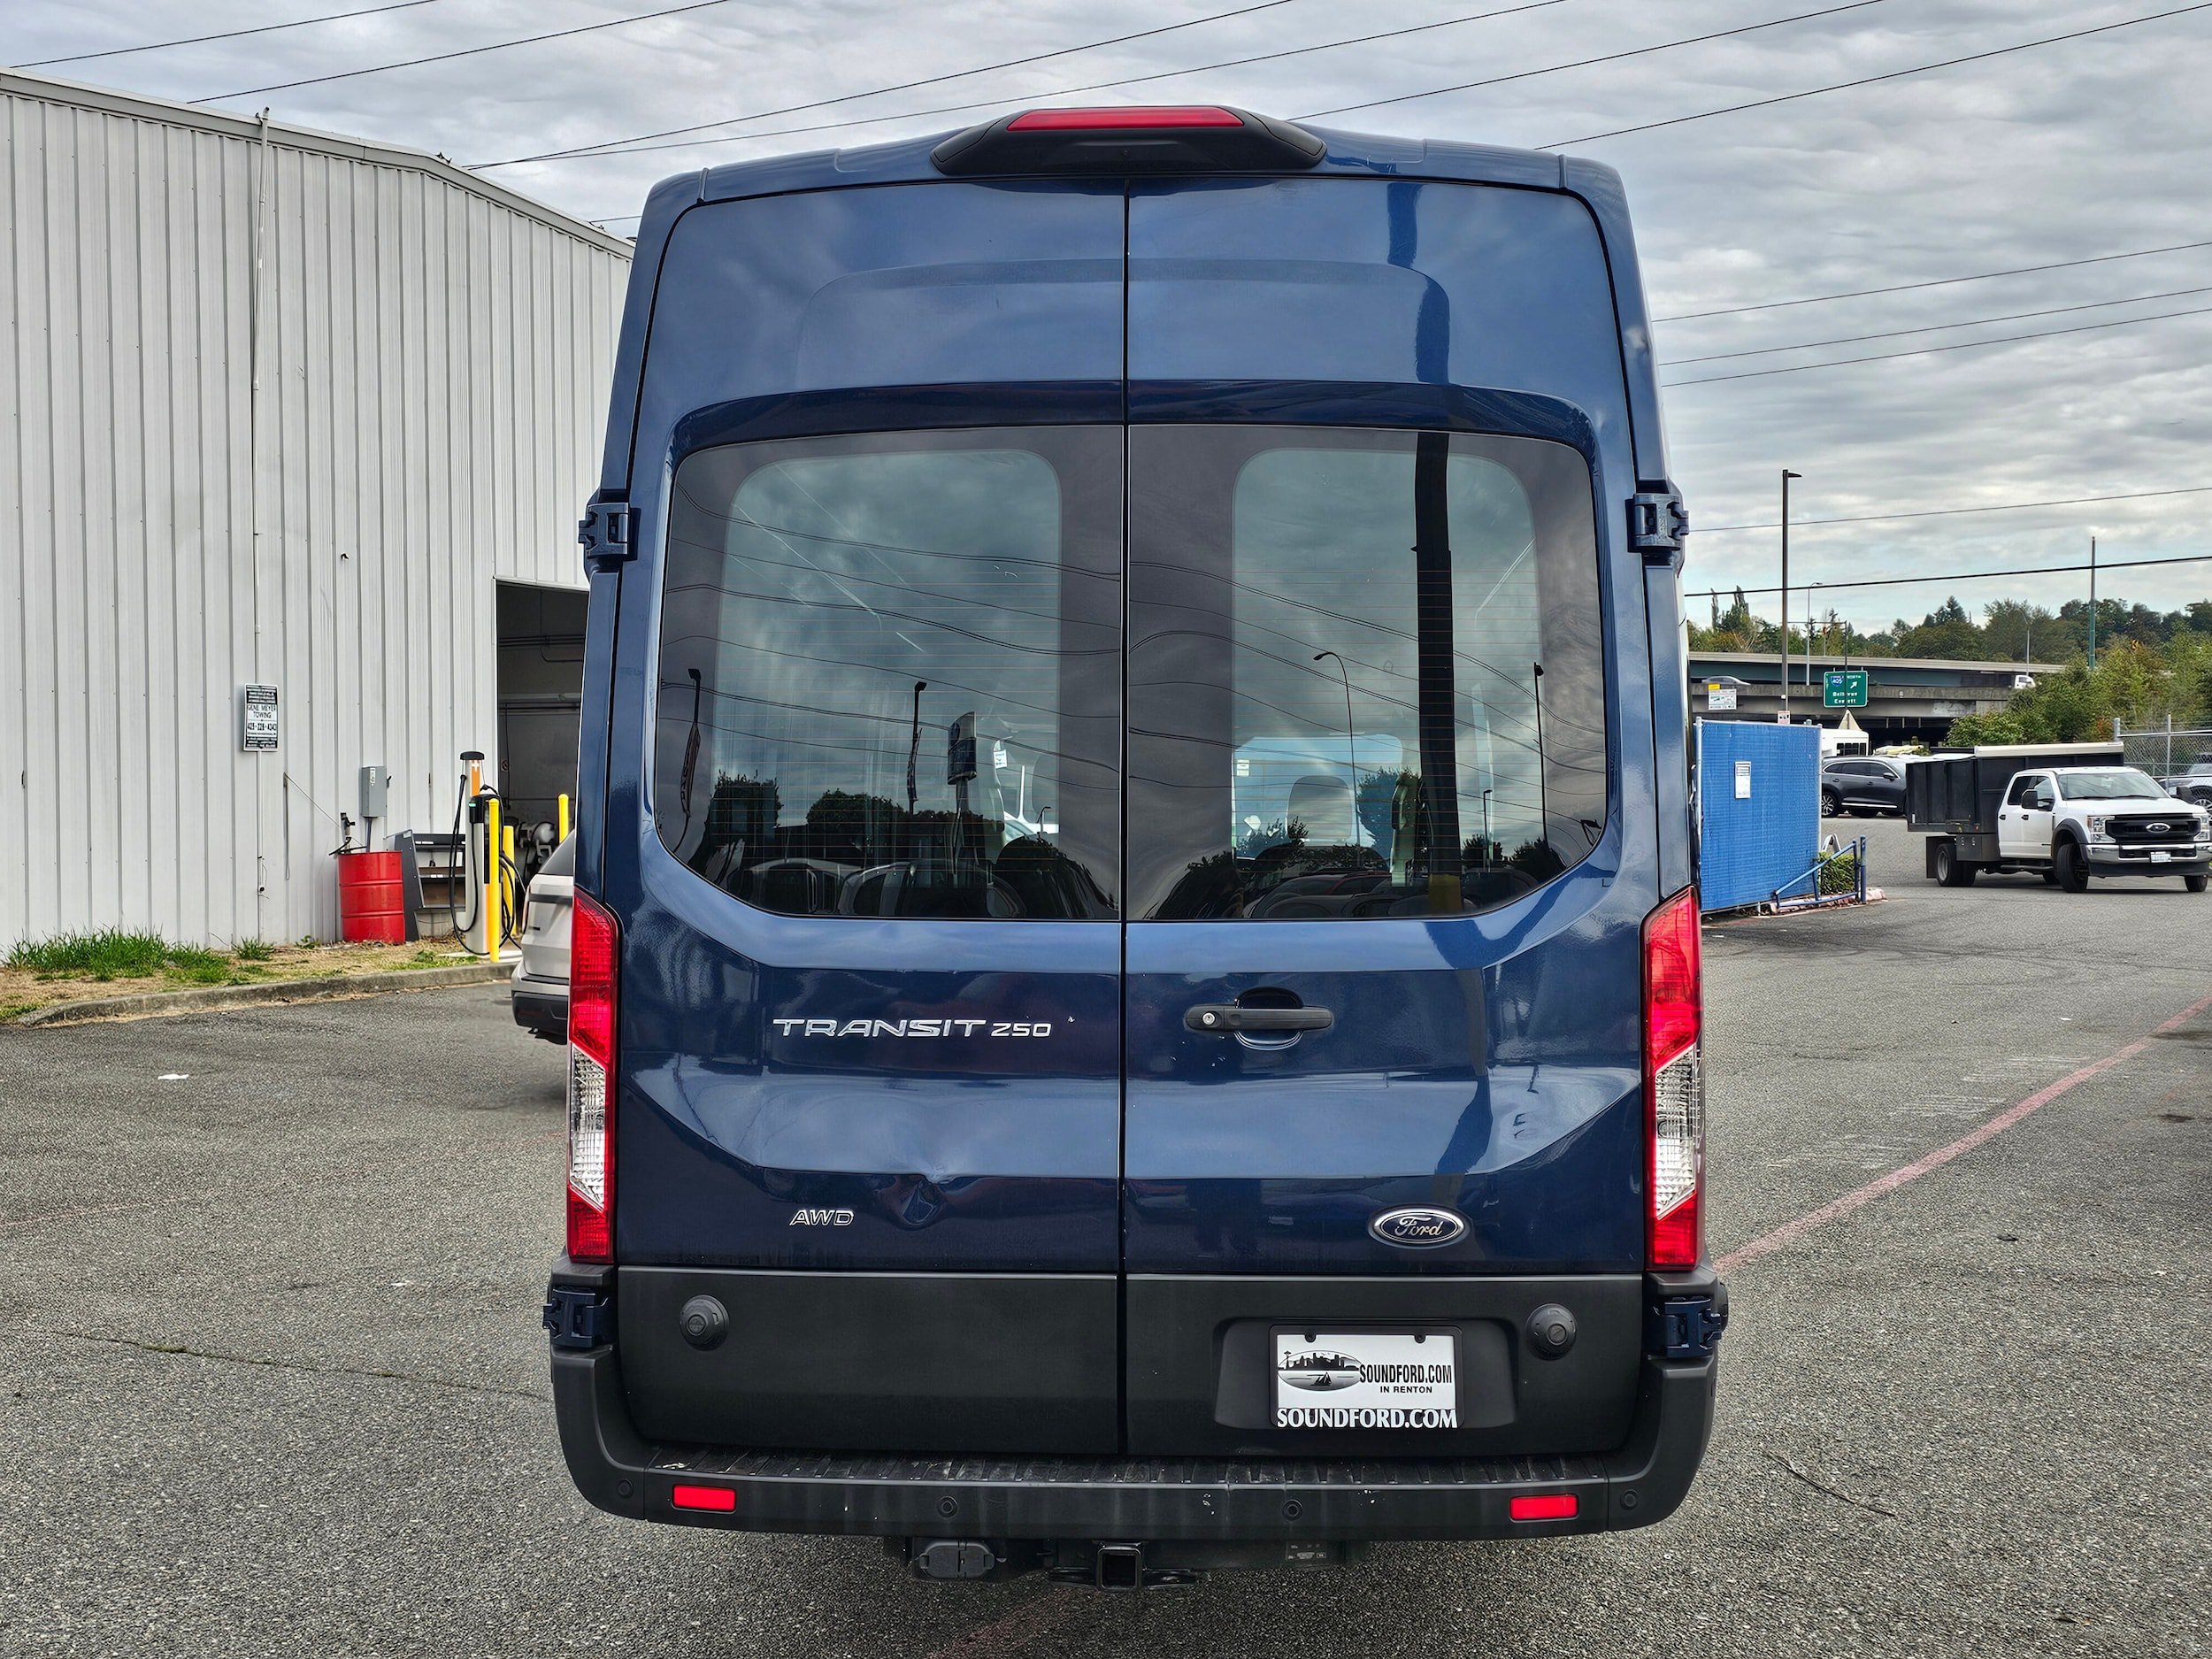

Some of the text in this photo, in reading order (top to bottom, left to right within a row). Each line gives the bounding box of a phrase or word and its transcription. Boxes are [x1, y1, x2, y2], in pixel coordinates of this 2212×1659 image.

[772, 1018, 1052, 1037] TRANSIT 250
[788, 1209, 855, 1226] AWD
[1394, 1216, 1444, 1236] Ford
[1359, 1364, 1452, 1384] SOUNDFORD.COM
[1277, 1408, 1458, 1429] SOUNDFORD.COM
